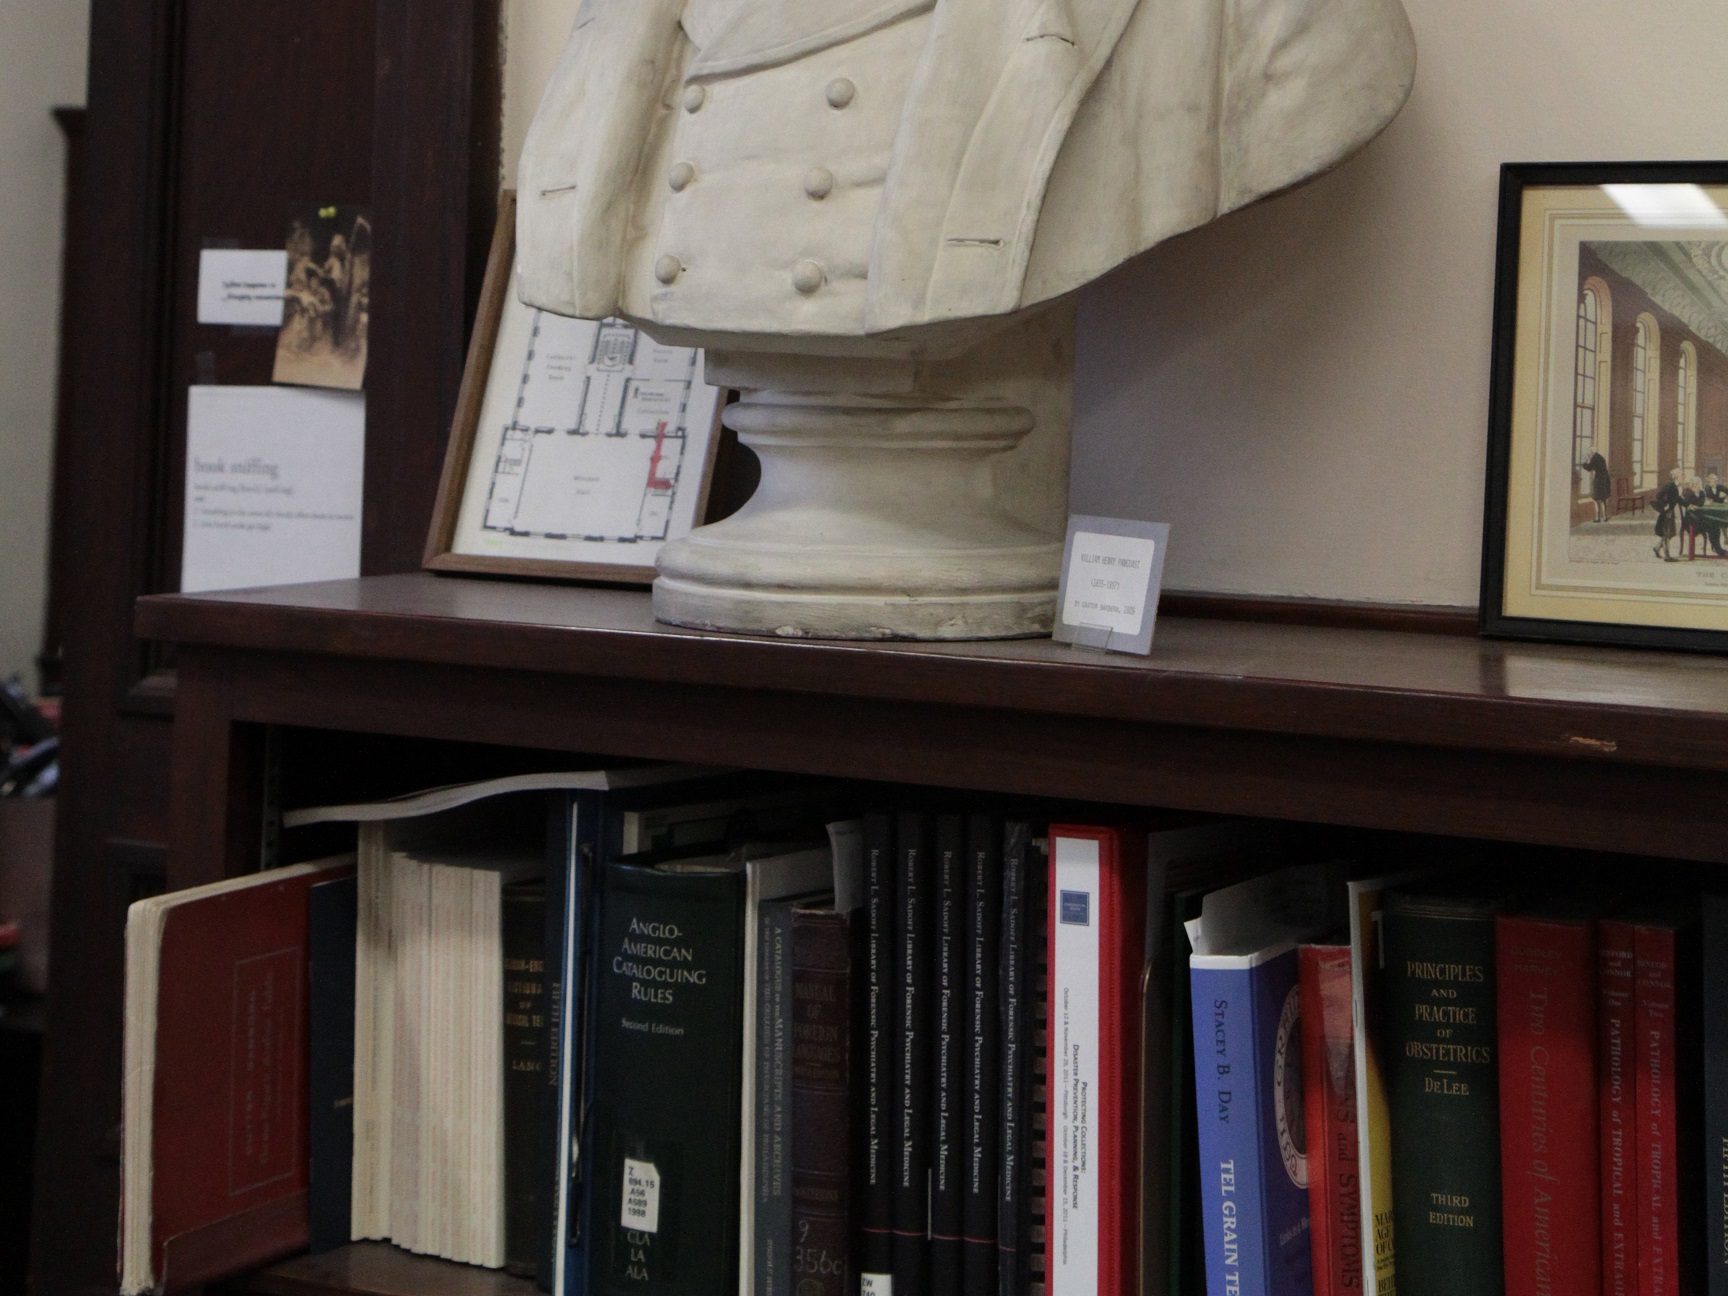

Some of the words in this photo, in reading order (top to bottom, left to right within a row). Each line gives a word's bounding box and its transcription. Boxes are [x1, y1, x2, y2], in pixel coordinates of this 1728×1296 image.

[1081, 553, 1100, 564] WILLIAM
[1102, 556, 1116, 566] HENRY
[871, 849, 879, 883] ROBERT
[907, 849, 916, 882] ROBERT
[943, 851, 952, 885] ROBERT
[976, 852, 985, 885] ROBERT
[1010, 859, 1019, 892] ROBERT
[629, 917, 683, 939] ANGLO-
[622, 937, 692, 962] AMERICAN
[870, 934, 879, 970] LIBRARY
[906, 934, 915, 970] LIBRARY
[942, 936, 951, 973] LIBRARY
[975, 937, 984, 974] LIBRARY
[1008, 944, 1018, 980] LIBRARY
[613, 956, 706, 984] CATALOGUING
[1406, 960, 1484, 982] PRINCIPLES
[632, 982, 672, 1004] RULES
[870, 986, 879, 1028] FORENSIC
[905, 986, 914, 1029] FORENSIC
[1431, 988, 1457, 998] AND
[622, 1018, 648, 1032] Second
[652, 1022, 684, 1036] Edition
[941, 989, 950, 1032] FORENSIC
[974, 991, 983, 1033] FORENSIC
[1007, 998, 1017, 1040] FORENSIC
[1415, 1004, 1477, 1024] PRACTICE
[1214, 999, 1228, 1057] STACEY
[1436, 1028, 1453, 1038] OF
[774, 1018, 784, 1100] MANUSCRIPTS
[870, 1030, 878, 1084] PSYCHIATRY
[904, 1031, 914, 1085] PSYCHIATRY
[940, 1034, 950, 1088] PSYCHIATRY
[974, 1036, 983, 1090] PSYCHIATRY
[1406, 1042, 1490, 1064] OBSTETRICS
[1610, 1018, 1621, 1104] PATHOLOGY
[1007, 1044, 1016, 1098] PSYCHIATRY
[1216, 1064, 1230, 1080] B.
[1650, 1030, 1662, 1117] PATHOLOGY
[1218, 1090, 1232, 1124] DAY
[1530, 1045, 1553, 1153] Centuries
[773, 1105, 781, 1131] AND
[870, 1107, 878, 1134] LEGAL
[903, 1109, 913, 1138] LEGAL
[939, 1112, 949, 1140] LEGAL
[973, 1115, 982, 1143] LEGAL
[1611, 1110, 1622, 1123] of
[1651, 1123, 1660, 1136] of
[1005, 1122, 1015, 1151] LEGAL
[772, 1135, 781, 1196] ARCHIVES
[869, 1139, 878, 1184] MEDICINE
[903, 1140, 912, 1187] MEDICINE
[939, 1144, 948, 1190] MEDICINE
[972, 1146, 981, 1194] MEDICINE
[1005, 1154, 1014, 1202] MEDICINE
[1220, 1160, 1235, 1196] TEL
[1612, 1128, 1623, 1196] TROPICAL
[1651, 1142, 1662, 1210] TROPICAL
[1430, 1193, 1470, 1208] THIRD
[1612, 1203, 1622, 1226] and
[1222, 1201, 1238, 1267] GRAIN
[1338, 1173, 1360, 1288] SYMPTOMS
[1429, 1211, 1473, 1227] EDITION
[1651, 1216, 1662, 1240] and
[630, 1248, 646, 1263] LA
[625, 1265, 648, 1281] ALA
